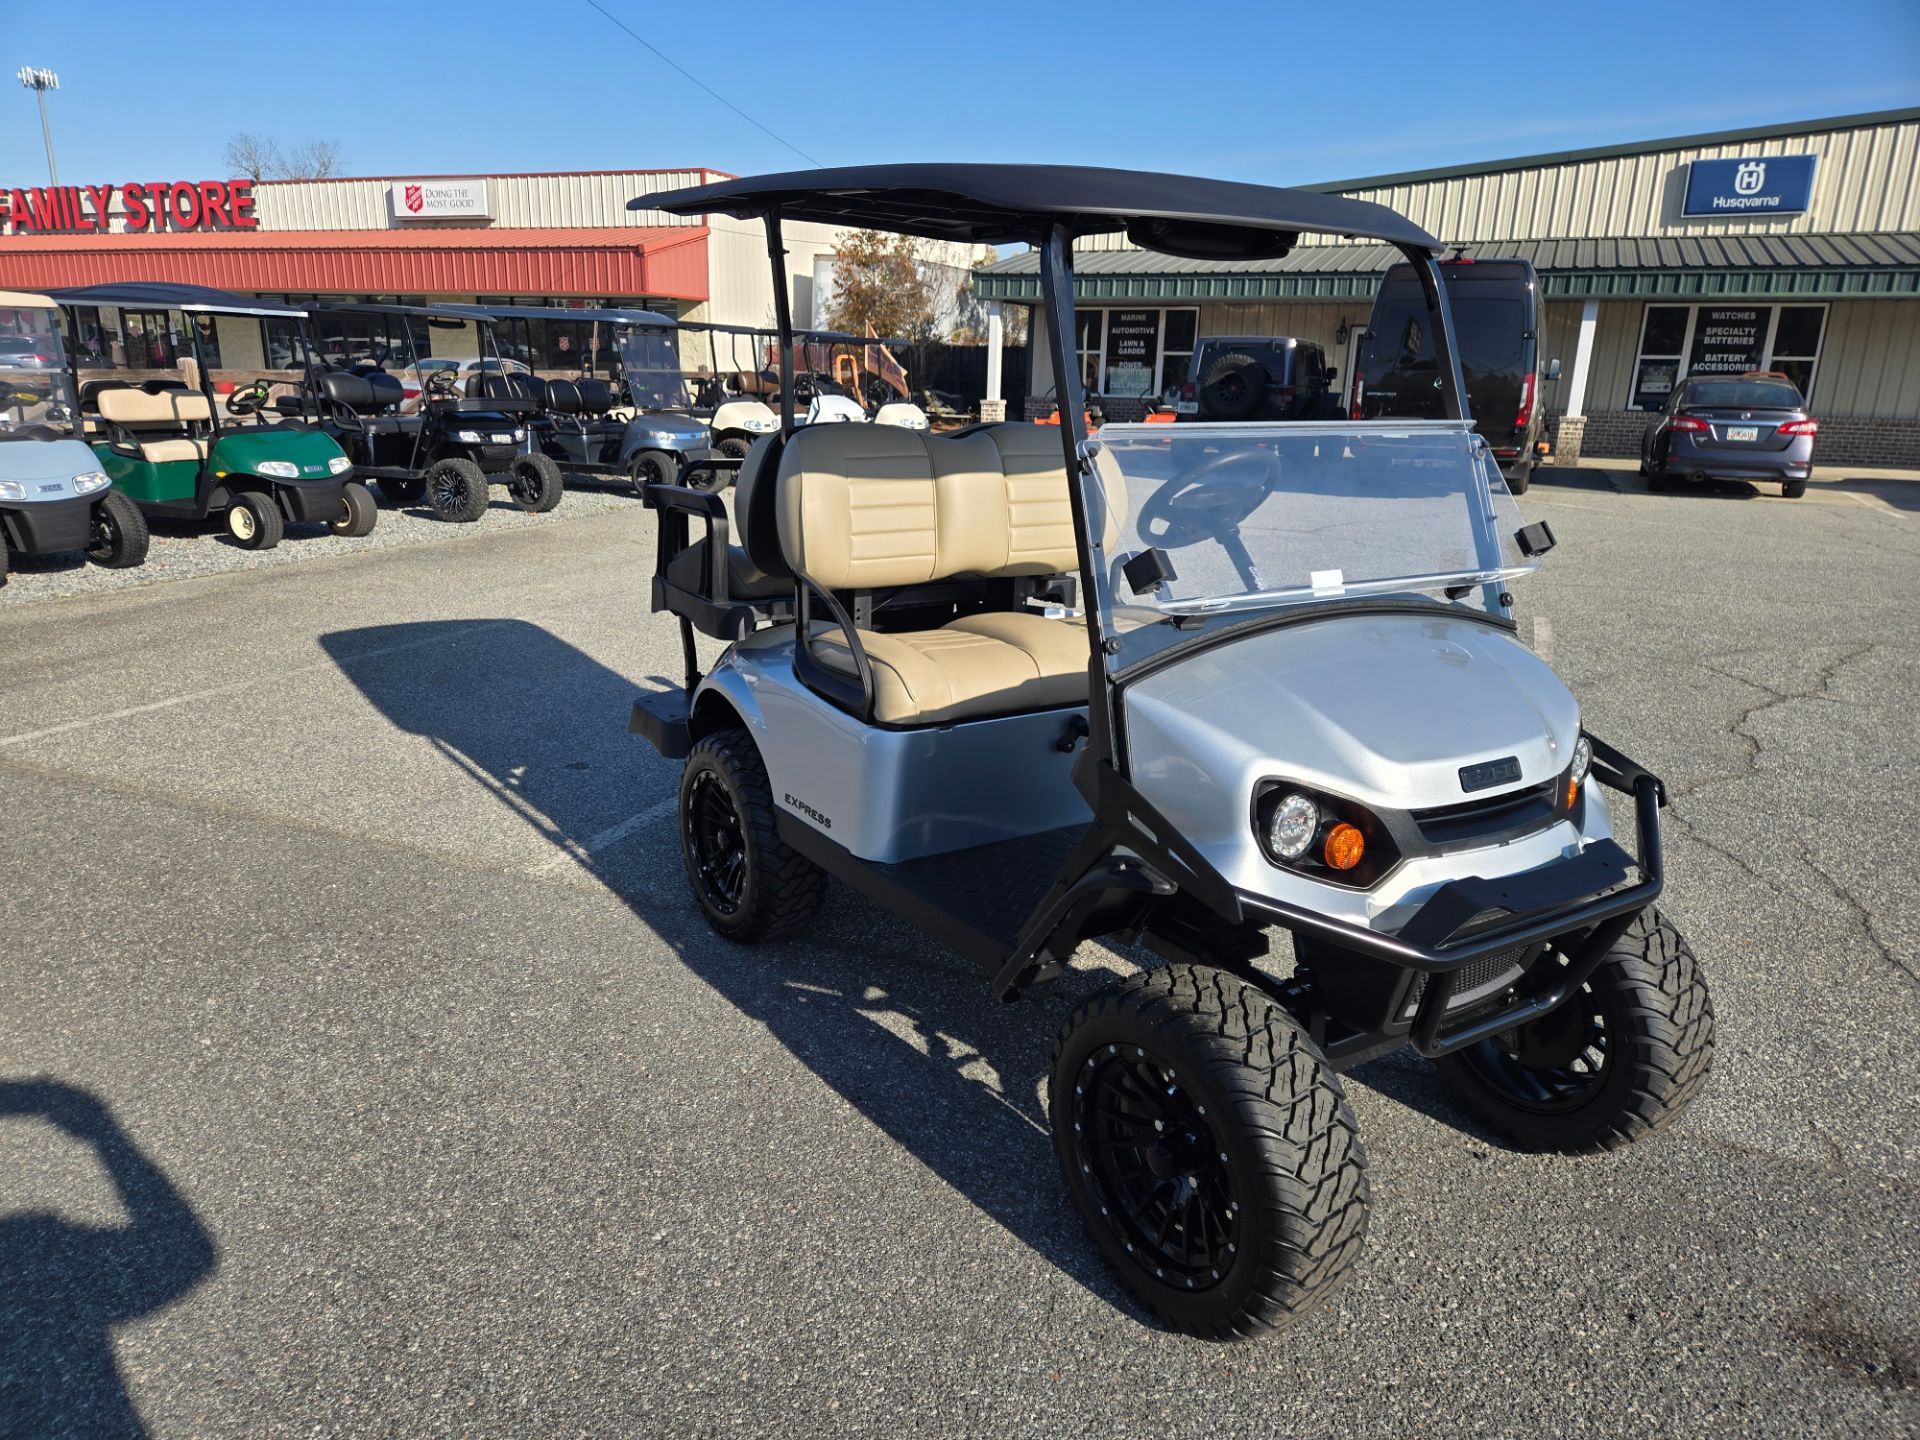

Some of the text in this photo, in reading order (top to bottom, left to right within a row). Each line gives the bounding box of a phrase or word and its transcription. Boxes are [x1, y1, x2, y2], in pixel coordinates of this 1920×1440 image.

[425, 188, 452, 198] DOING
[454, 188, 469, 198] THE
[122, 179, 257, 229] STORE
[426, 199, 474, 208] MOST GOOD
[1713, 196, 1780, 208] Husqvarna
[1711, 311, 1757, 320] WATCHES
[1705, 327, 1757, 335] SPECIALTY
[1703, 336, 1755, 345] BATTERIES
[1118, 347, 1146, 355] GARDEN
[1704, 353, 1748, 362] BATTERY
[1692, 363, 1757, 371] ACCESSORIES
[784, 793, 832, 829] EXPRESS
